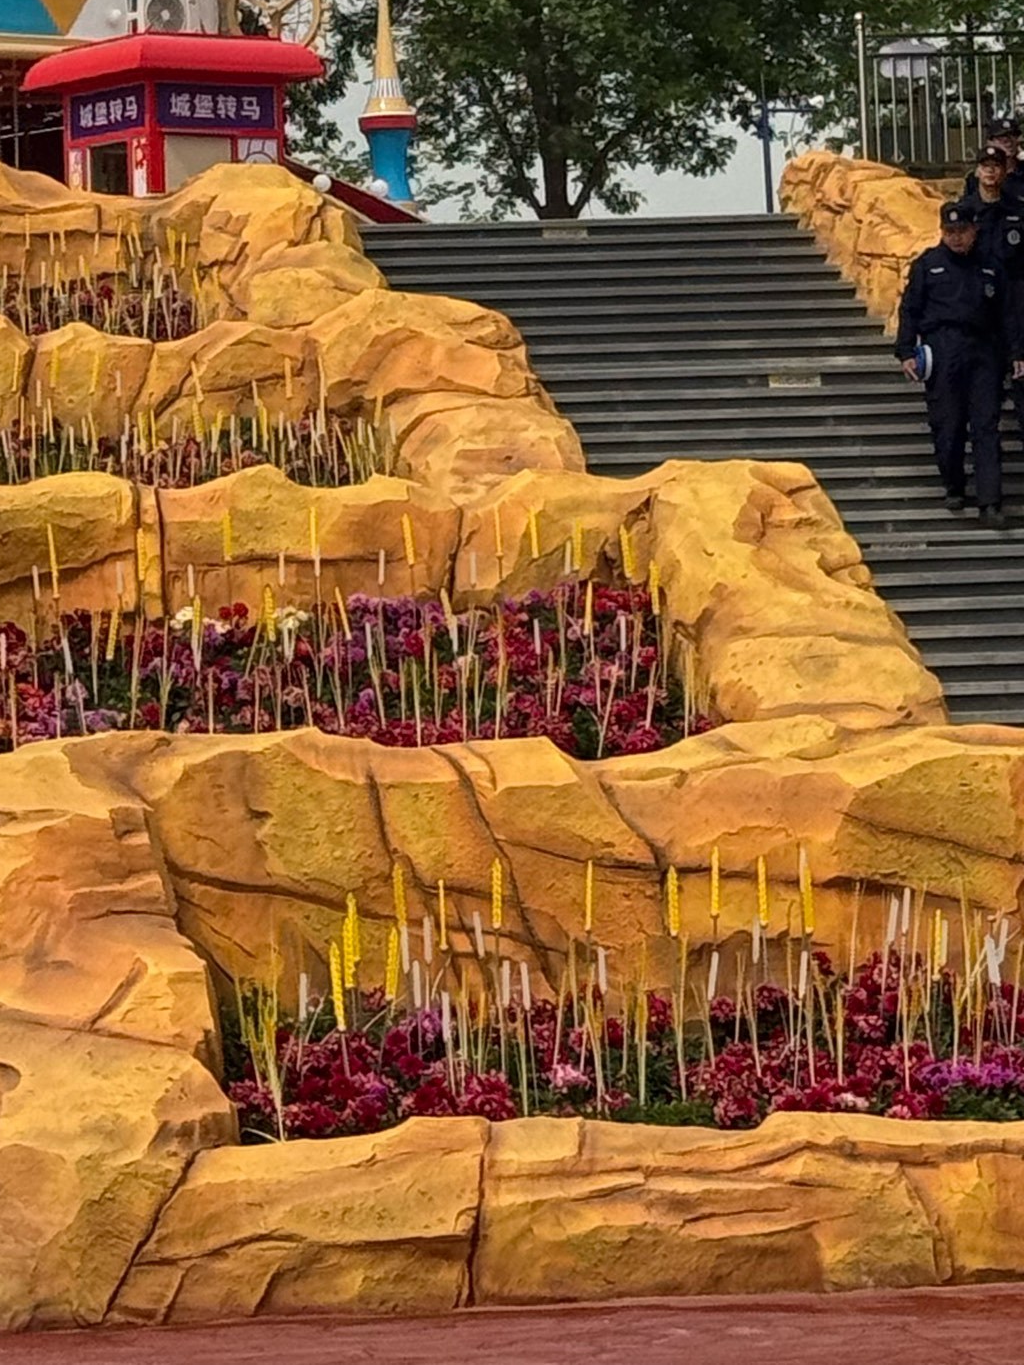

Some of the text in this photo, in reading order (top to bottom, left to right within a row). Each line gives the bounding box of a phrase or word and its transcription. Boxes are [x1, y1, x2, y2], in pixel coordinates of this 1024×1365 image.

[79, 95, 138, 129] 城堡转马
[170, 93, 261, 121] 城堡转马
